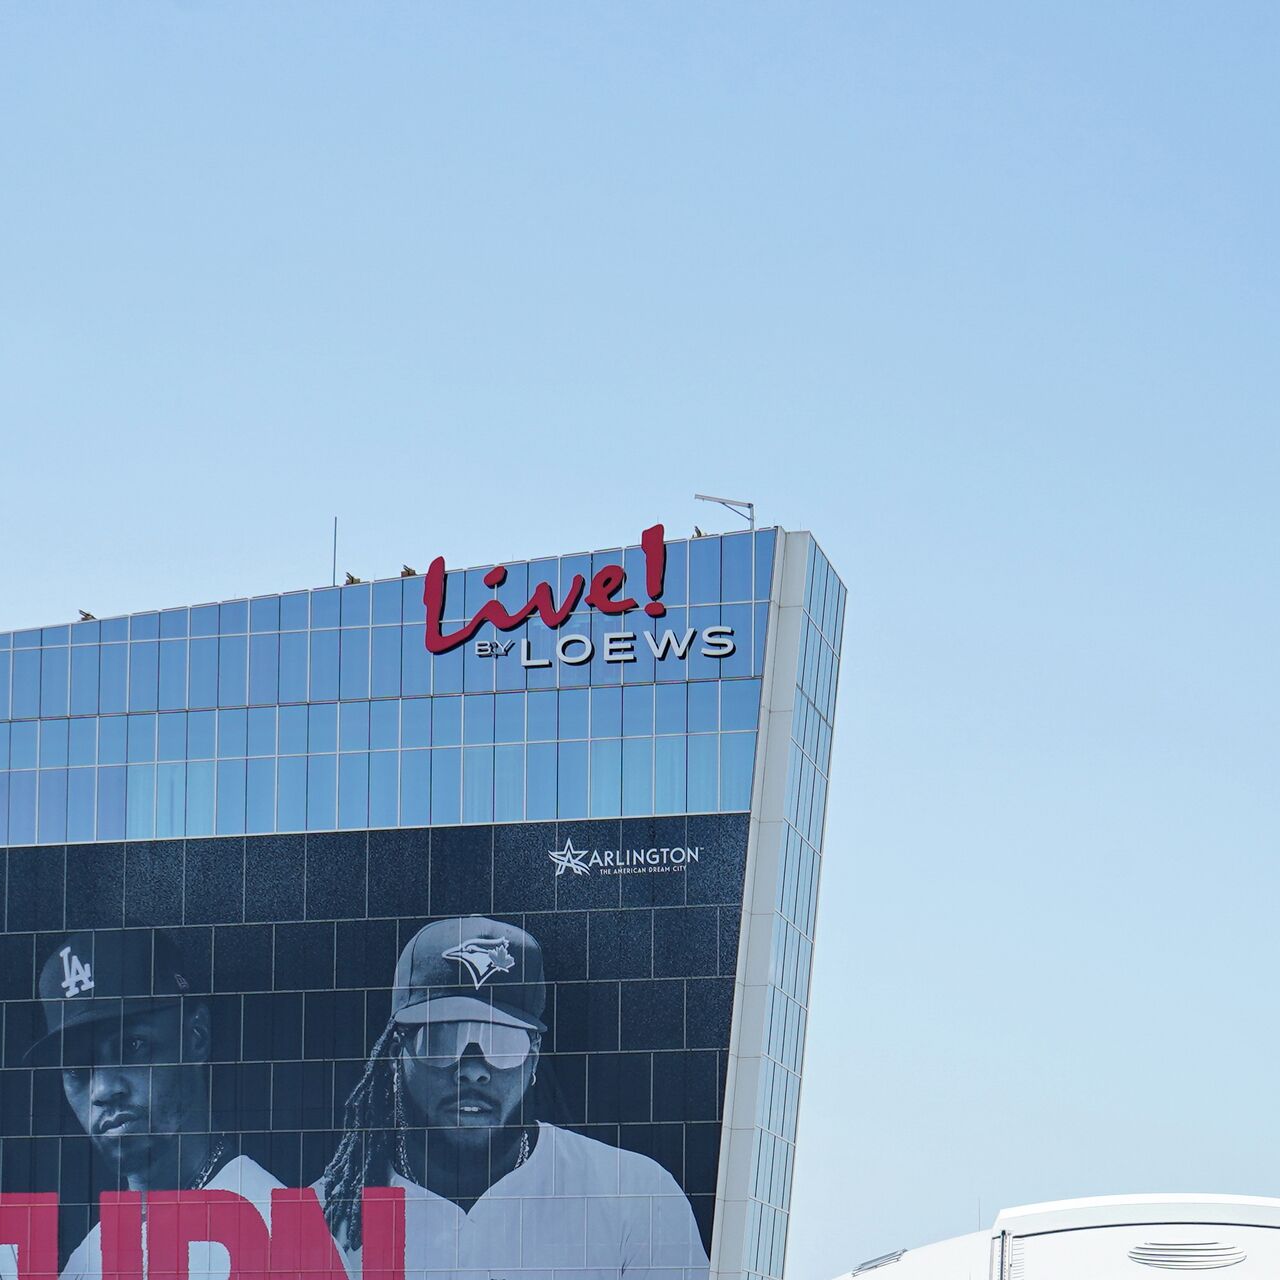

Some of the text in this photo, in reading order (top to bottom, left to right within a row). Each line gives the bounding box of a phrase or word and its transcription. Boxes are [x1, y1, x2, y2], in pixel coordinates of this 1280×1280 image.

[423, 524, 665, 653] Live!
[474, 625, 736, 668] BY LOEWS
[588, 846, 699, 867] ARLINGTON
[613, 866, 646, 875] AMERICAN
[648, 865, 670, 873] DREAM
[672, 864, 687, 872] CITY
